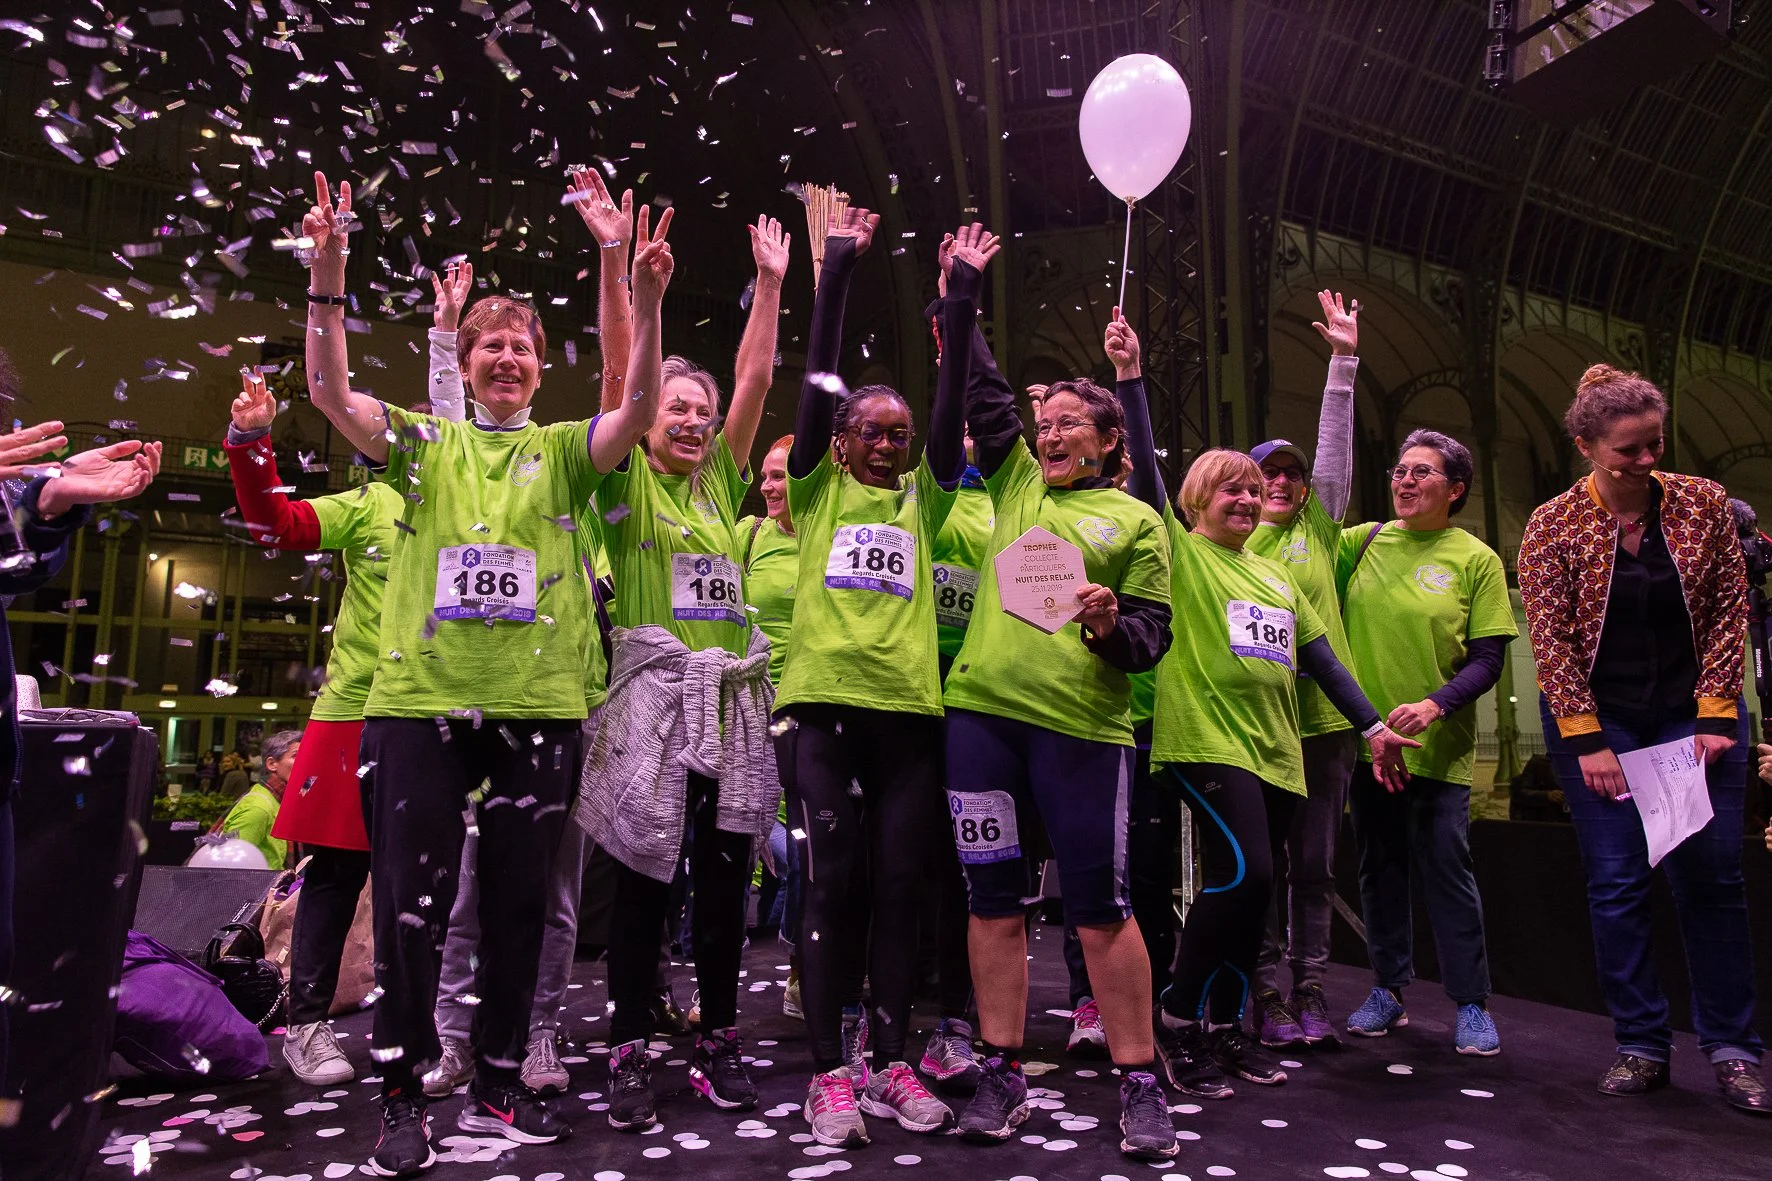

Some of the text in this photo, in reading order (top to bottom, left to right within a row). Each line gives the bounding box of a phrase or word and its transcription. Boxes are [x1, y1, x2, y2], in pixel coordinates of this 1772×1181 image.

[1023, 542, 1058, 552] TROPHÉE
[483, 552, 514, 560] FONDATION
[847, 547, 905, 575] 186
[1024, 554, 1059, 562] COLLECTE
[1020, 563, 1067, 573] PARTICULIERS
[453, 570, 519, 598] 186
[851, 577, 866, 585] DES
[689, 577, 737, 605] 186
[1031, 584, 1063, 593] 25.11.2019
[486, 596, 510, 604] Croisés
[439, 608, 457, 617] NUIT
[460, 606, 476, 614] DES
[512, 608, 532, 618] 2019
[1245, 621, 1289, 649] 186
[968, 851, 995, 860] RELAIS
